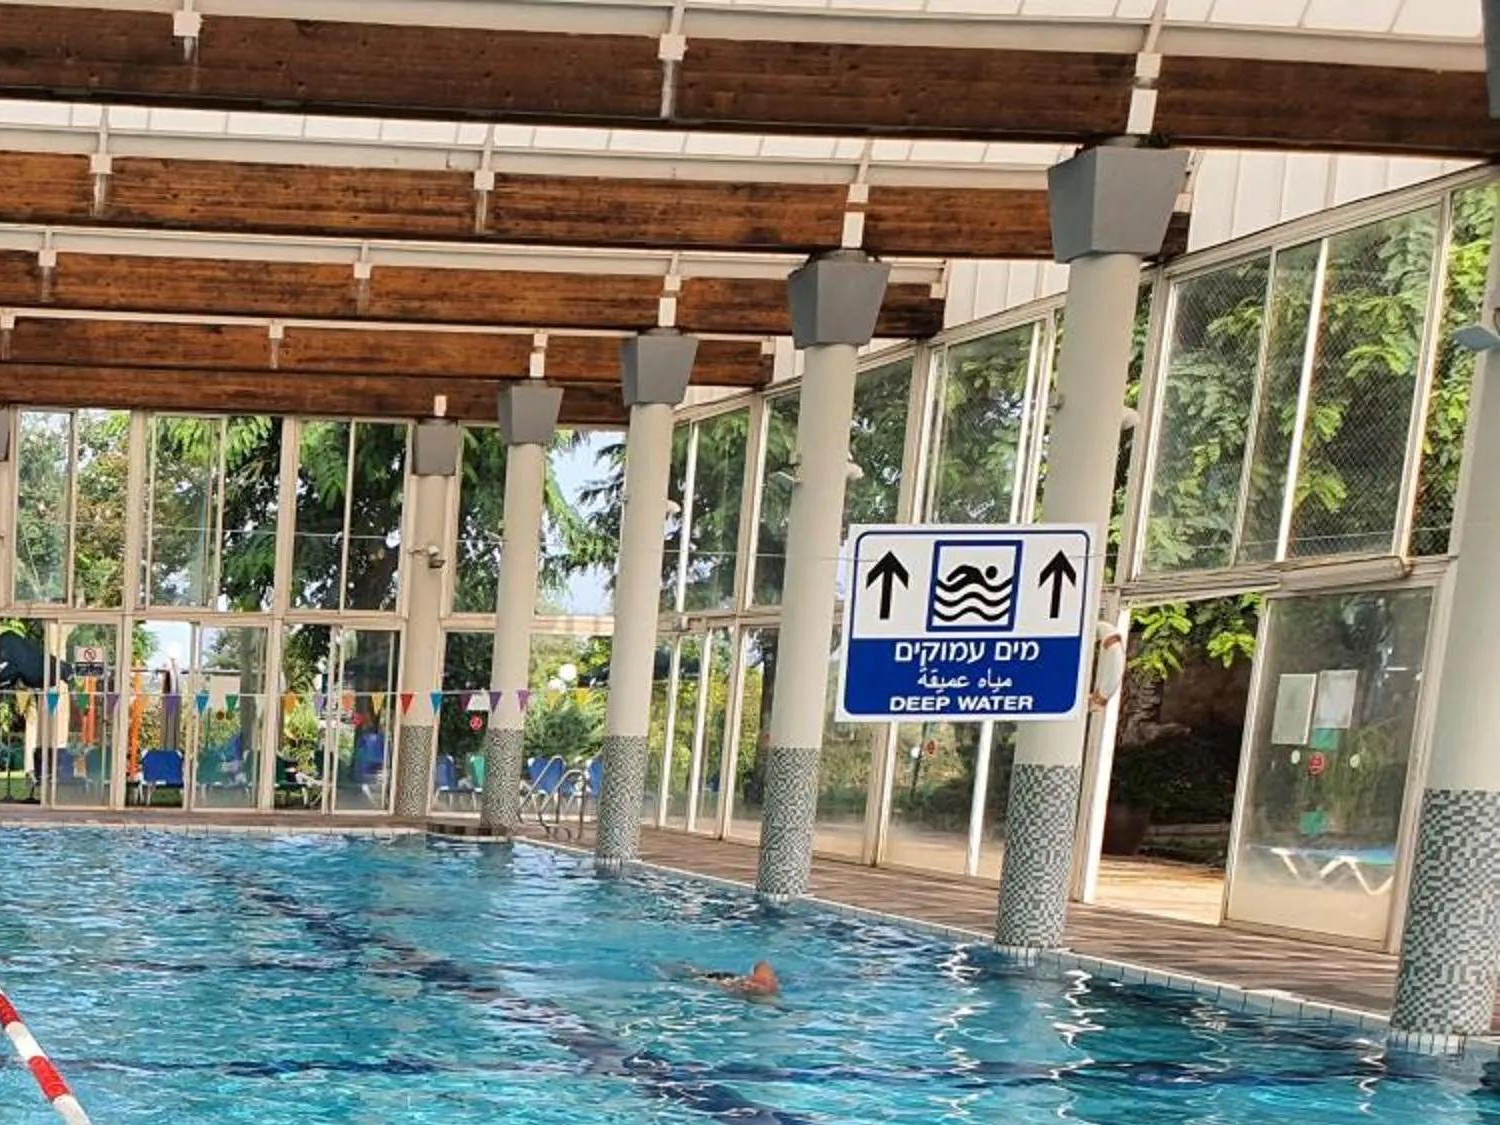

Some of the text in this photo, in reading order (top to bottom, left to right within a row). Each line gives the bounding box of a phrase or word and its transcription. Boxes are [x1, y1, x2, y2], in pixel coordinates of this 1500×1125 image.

[894, 640, 1040, 667] מים עמוקים
[916, 666, 1013, 694] مياه عميقة
[889, 695, 1034, 711] DEEP WATER
